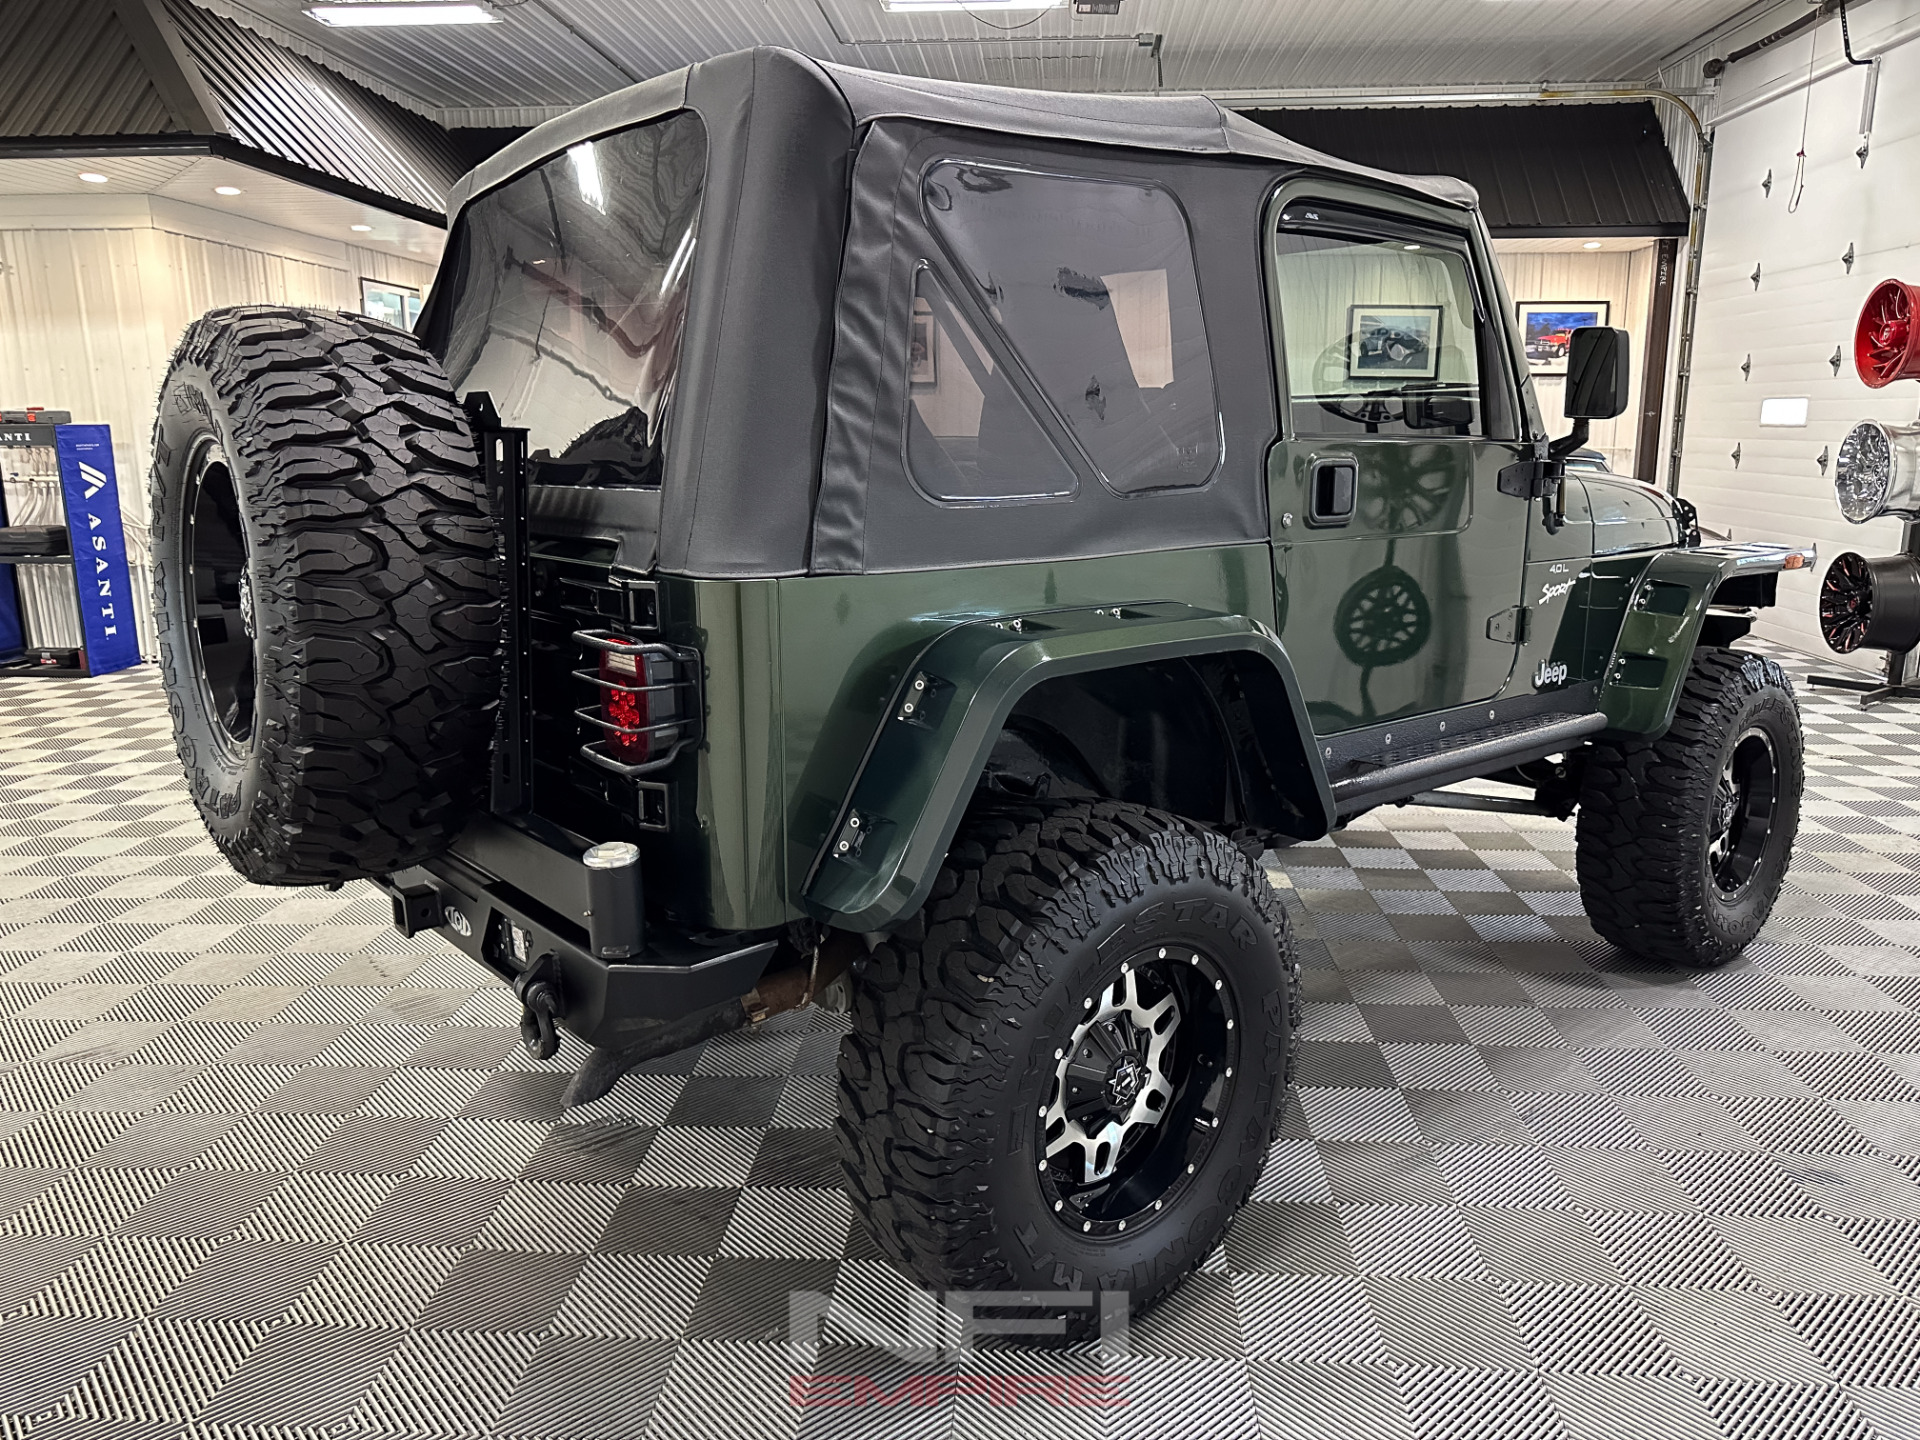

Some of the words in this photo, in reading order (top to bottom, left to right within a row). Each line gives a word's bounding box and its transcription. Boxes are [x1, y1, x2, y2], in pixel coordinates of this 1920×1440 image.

[0, 432, 32, 442] NTI
[87, 512, 117, 637] ASANTI
[1533, 659, 1568, 686] Jeep
